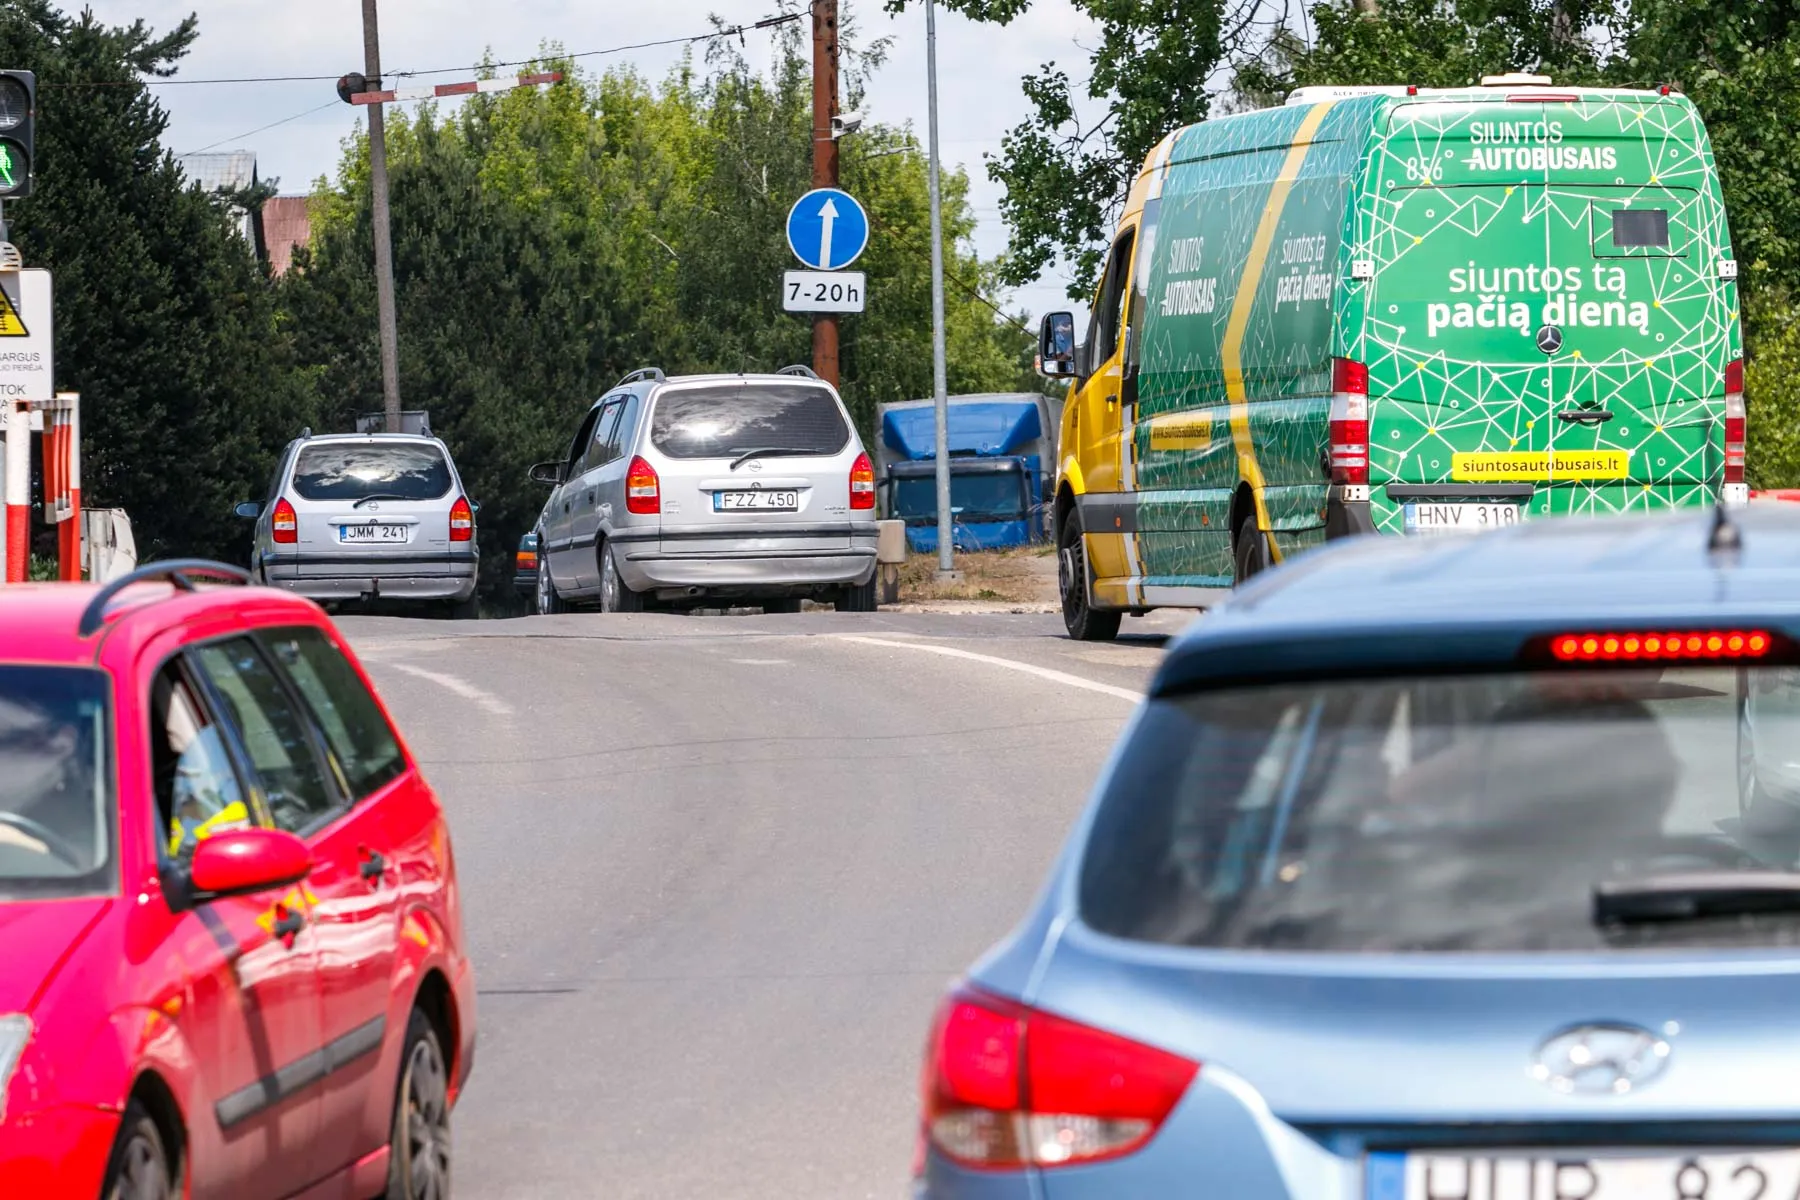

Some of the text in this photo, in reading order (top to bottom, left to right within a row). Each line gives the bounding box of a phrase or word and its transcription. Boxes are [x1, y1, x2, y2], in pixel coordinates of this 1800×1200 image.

[1469, 121, 1563, 144] SIUNTOS
[1407, 157, 1443, 180] 856
[1467, 147, 1617, 171] AUTOBUSAIS
[1168, 237, 1204, 274] SIUNTOS
[1281, 232, 1327, 269] siuntos tą
[1275, 265, 1332, 313] pačią dieną
[1449, 260, 1627, 299] siuntos tą
[1161, 277, 1216, 316] AUTOBUSAIS
[1428, 293, 1649, 337] pačią dieną
[1463, 458, 1619, 472] siuntosautobusais.lt
[724, 493, 795, 507] FZZ 450
[1419, 506, 1462, 524] HNV
[1477, 506, 1514, 525] 318
[349, 527, 374, 538] JMM
[383, 527, 404, 538] 241
